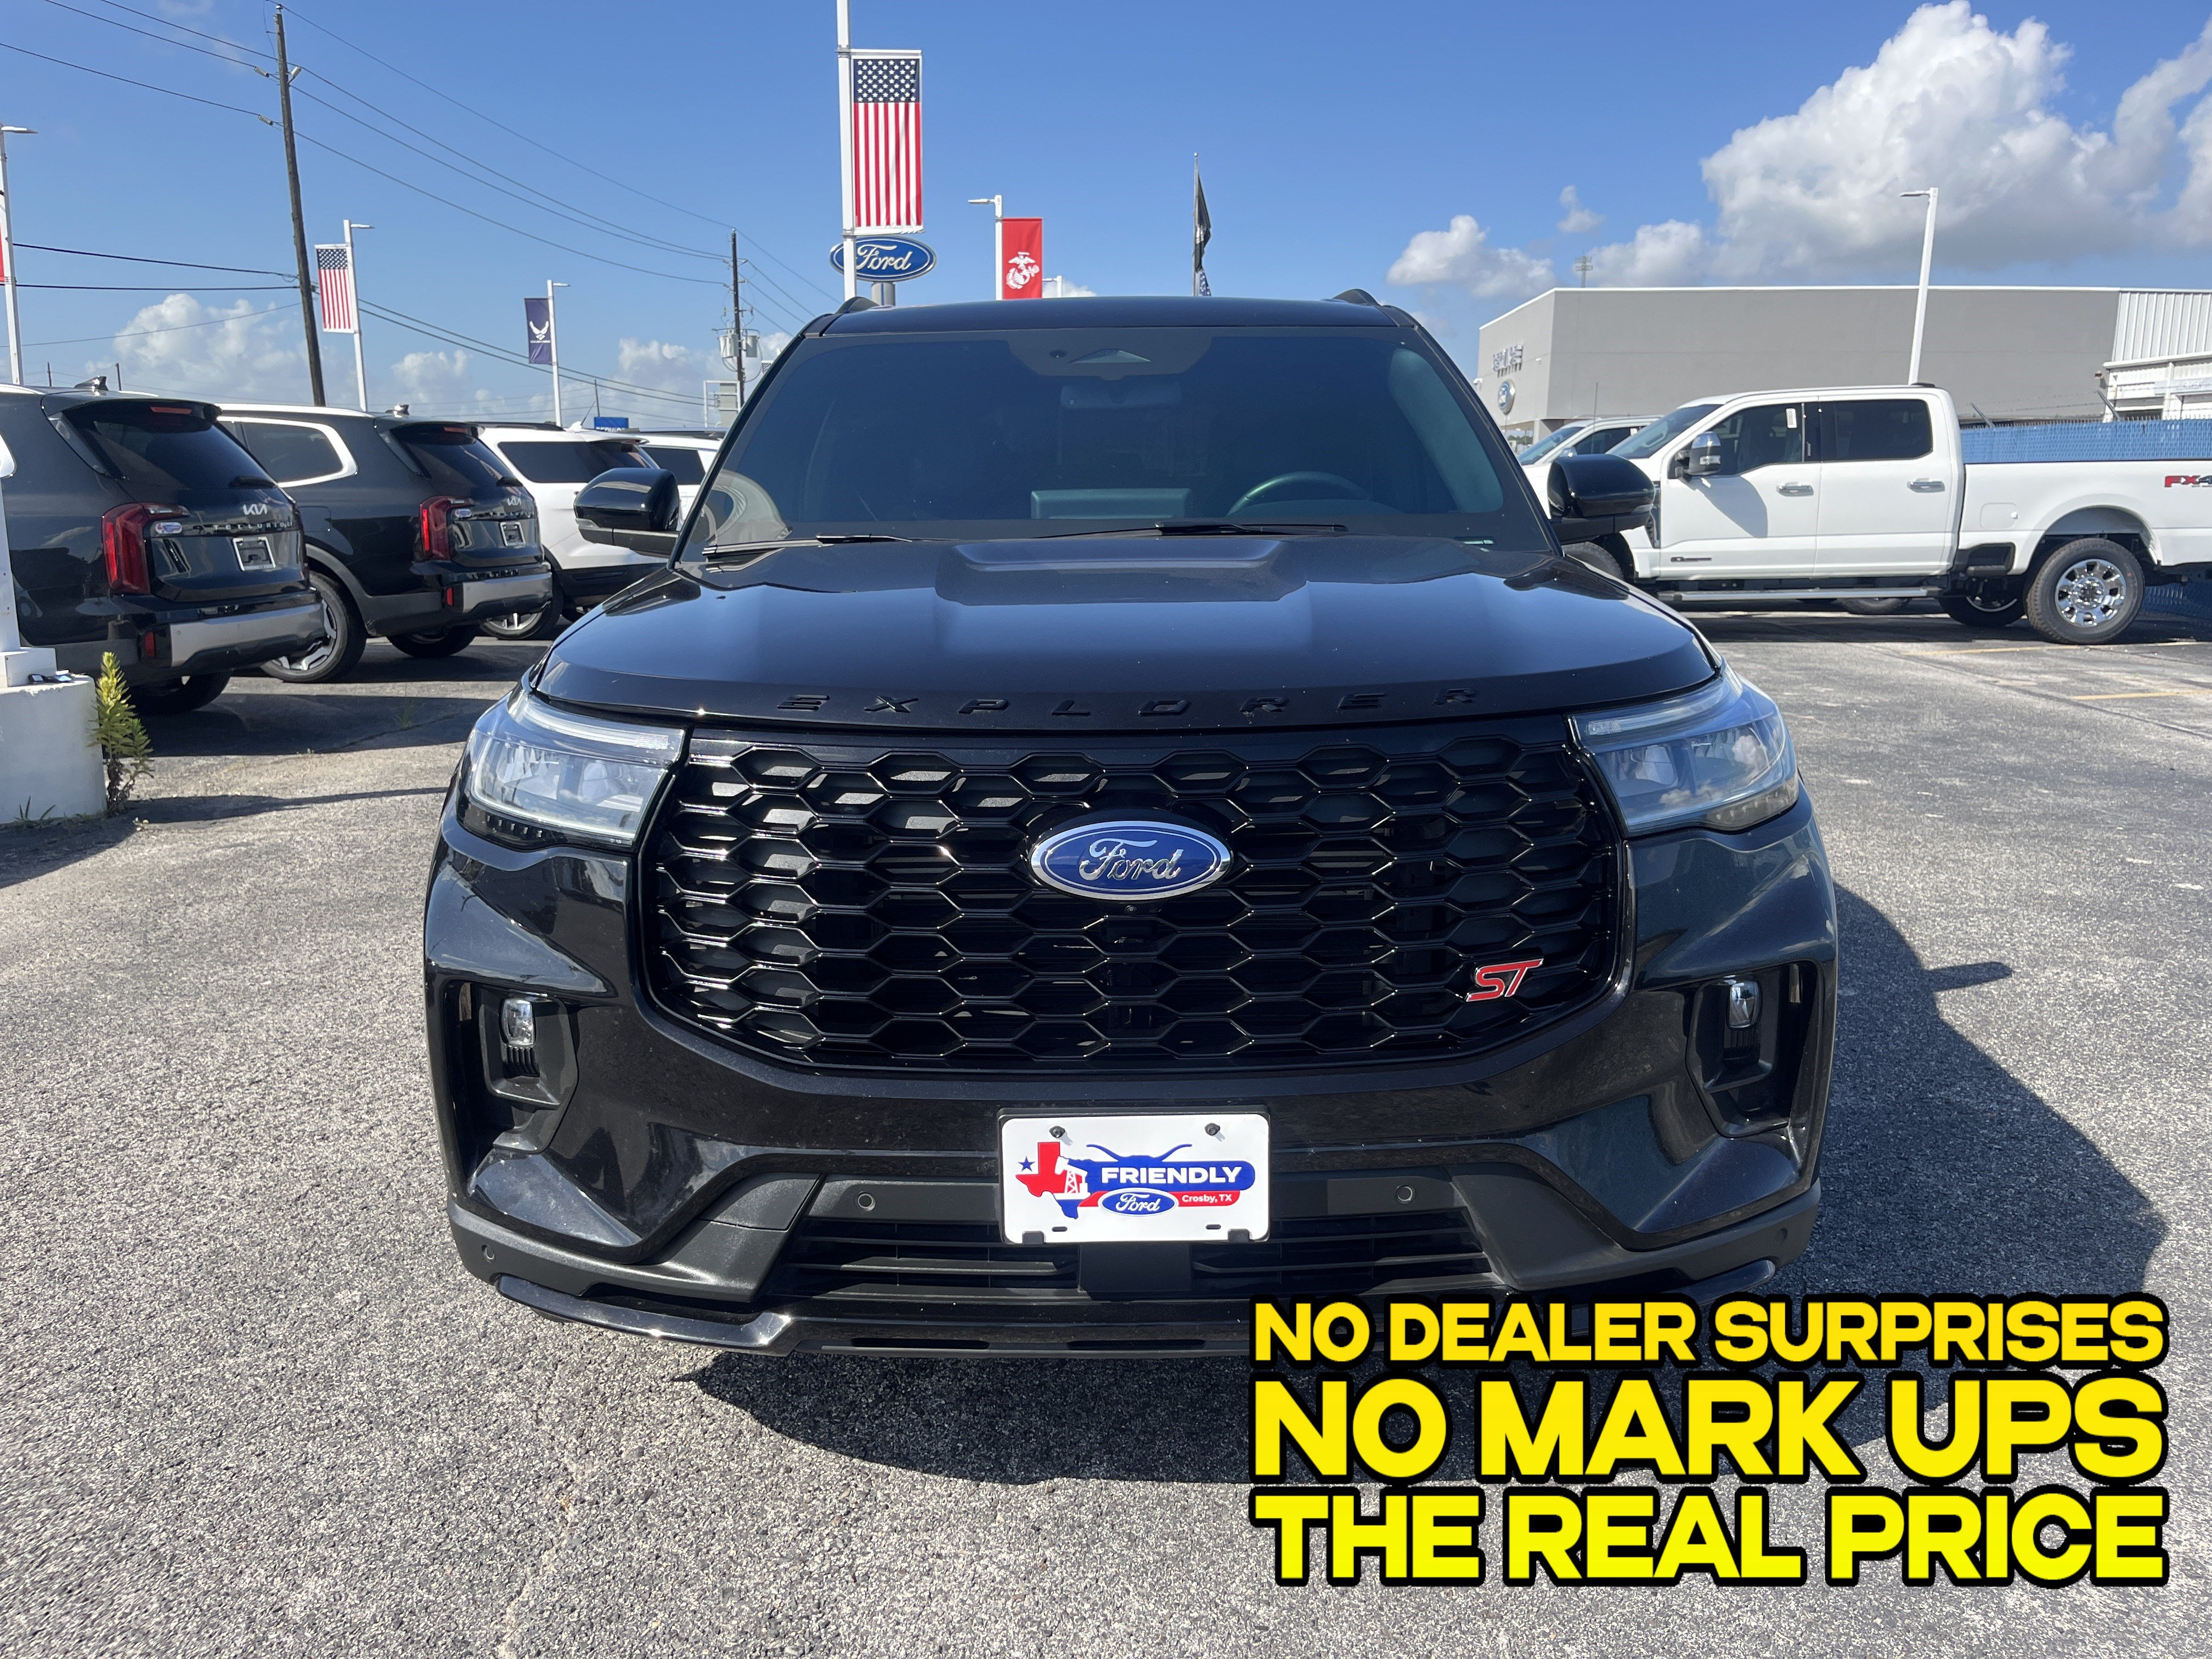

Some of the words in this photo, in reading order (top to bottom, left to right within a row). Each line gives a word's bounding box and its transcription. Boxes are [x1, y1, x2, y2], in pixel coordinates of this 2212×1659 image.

[855, 244, 913, 271] Ford
[2164, 475, 2212, 488] FX4
[242, 503, 268, 515] KIA
[776, 687, 1478, 716] EXPLORER
[1079, 838, 1184, 881] Ford
[1466, 958, 1544, 1002] ST
[1101, 1166, 1242, 1184] FRIENDLY
[1115, 1192, 1161, 1212] Ford
[1181, 1194, 1218, 1204] Crosby,
[1218, 1194, 1233, 1203] TX
